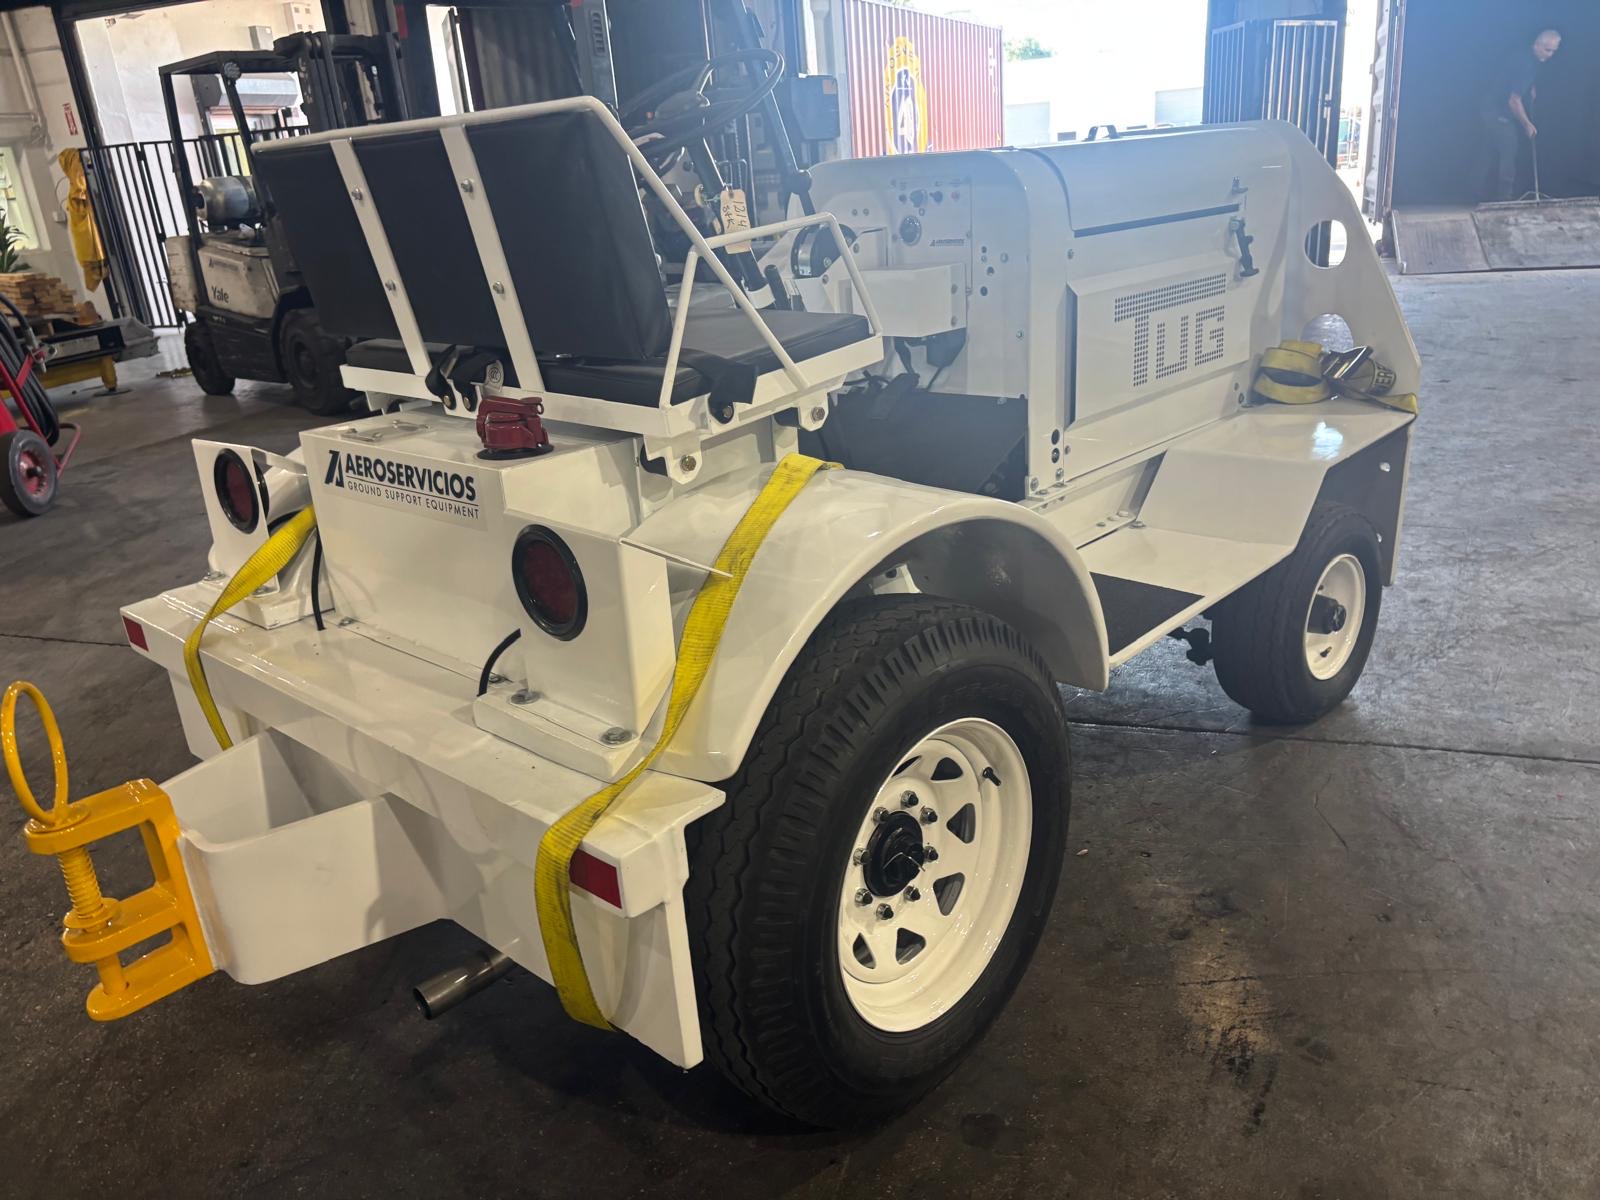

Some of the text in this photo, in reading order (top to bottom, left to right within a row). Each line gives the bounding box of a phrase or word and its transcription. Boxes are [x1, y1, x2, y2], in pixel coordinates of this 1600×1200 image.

[211, 285, 229, 304] Yale
[1114, 273, 1226, 387] TUG
[345, 453, 477, 501] AEROSERVICIOS
[347, 480, 479, 520] GROUND SUPPORT EQUIPMENT
